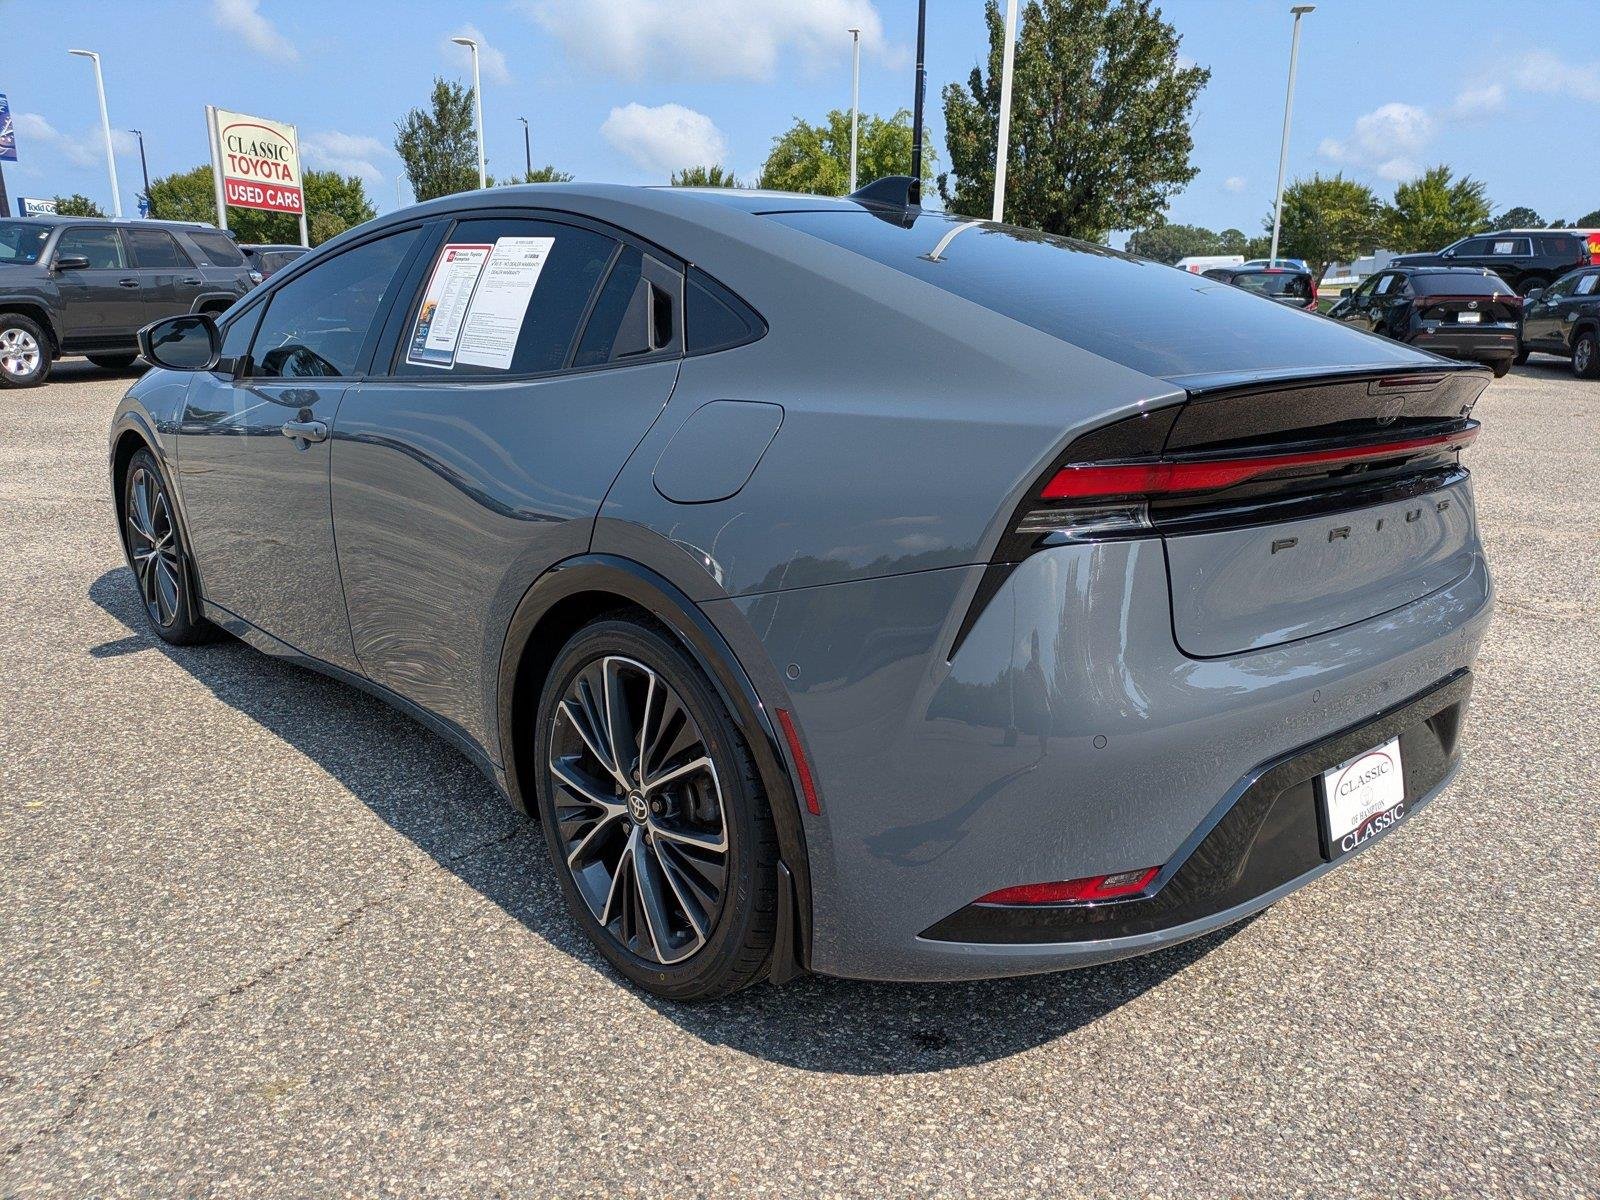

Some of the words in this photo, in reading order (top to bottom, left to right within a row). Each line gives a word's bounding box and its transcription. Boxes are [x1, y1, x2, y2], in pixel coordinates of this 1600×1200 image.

[227, 135, 289, 162] CLASSIC
[227, 154, 293, 181] TOYOTA
[228, 184, 263, 204] USED
[266, 189, 300, 208] CARS
[1271, 500, 1450, 554] PRIUS
[1340, 761, 1389, 797] CLASSIC
[1341, 803, 1405, 852] CLASSIC
